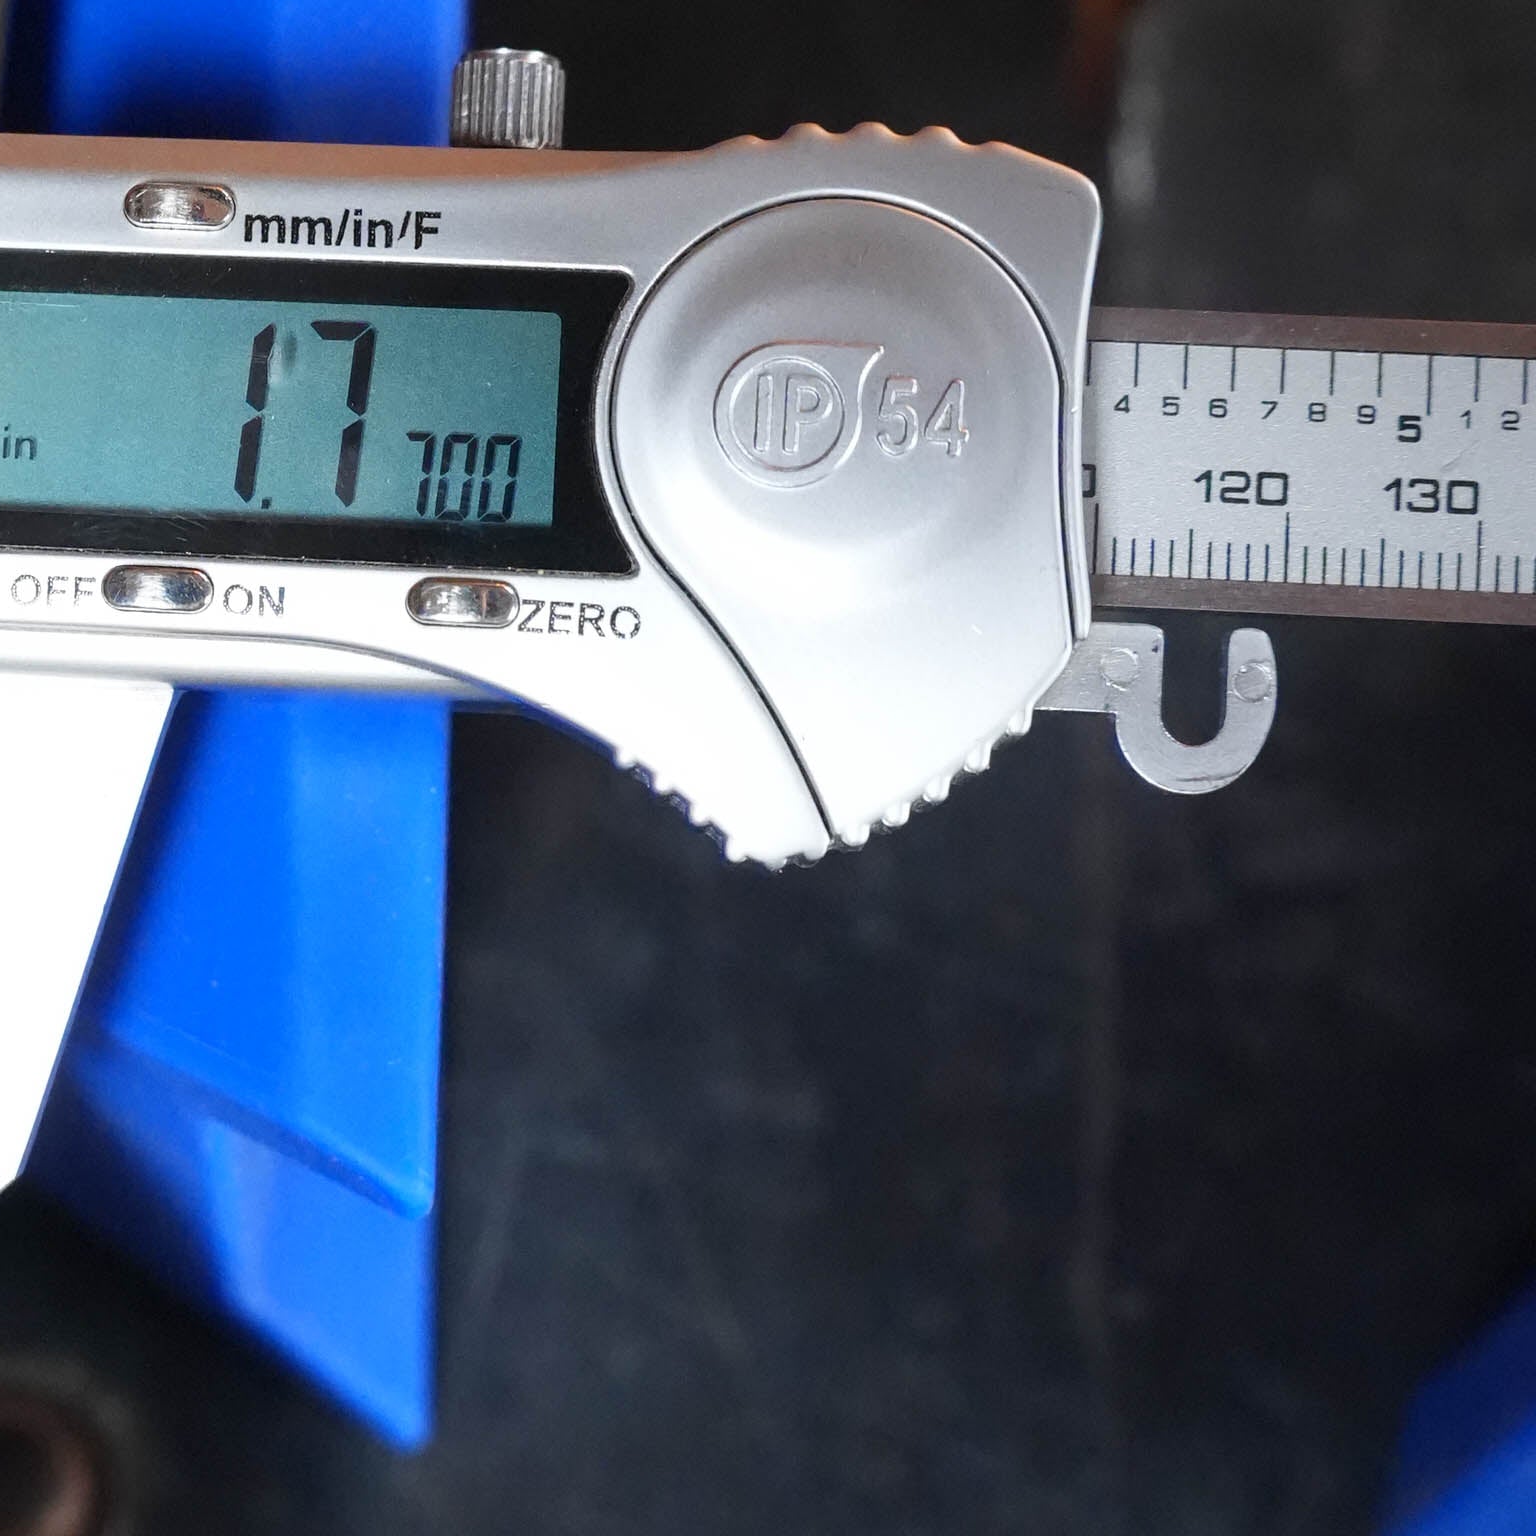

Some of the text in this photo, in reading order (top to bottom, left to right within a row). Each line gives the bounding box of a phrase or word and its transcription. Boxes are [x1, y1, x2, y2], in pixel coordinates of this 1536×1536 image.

[244, 208, 442, 250] mm/in/F
[751, 372, 970, 458] IP 54
[1113, 394, 1520, 444] 4 5 6 7 8 9 5 1 2
[2, 423, 38, 461] in
[1193, 469, 1480, 516] 120 130
[10, 574, 286, 617] OFF ON
[517, 598, 642, 640] ZERO
